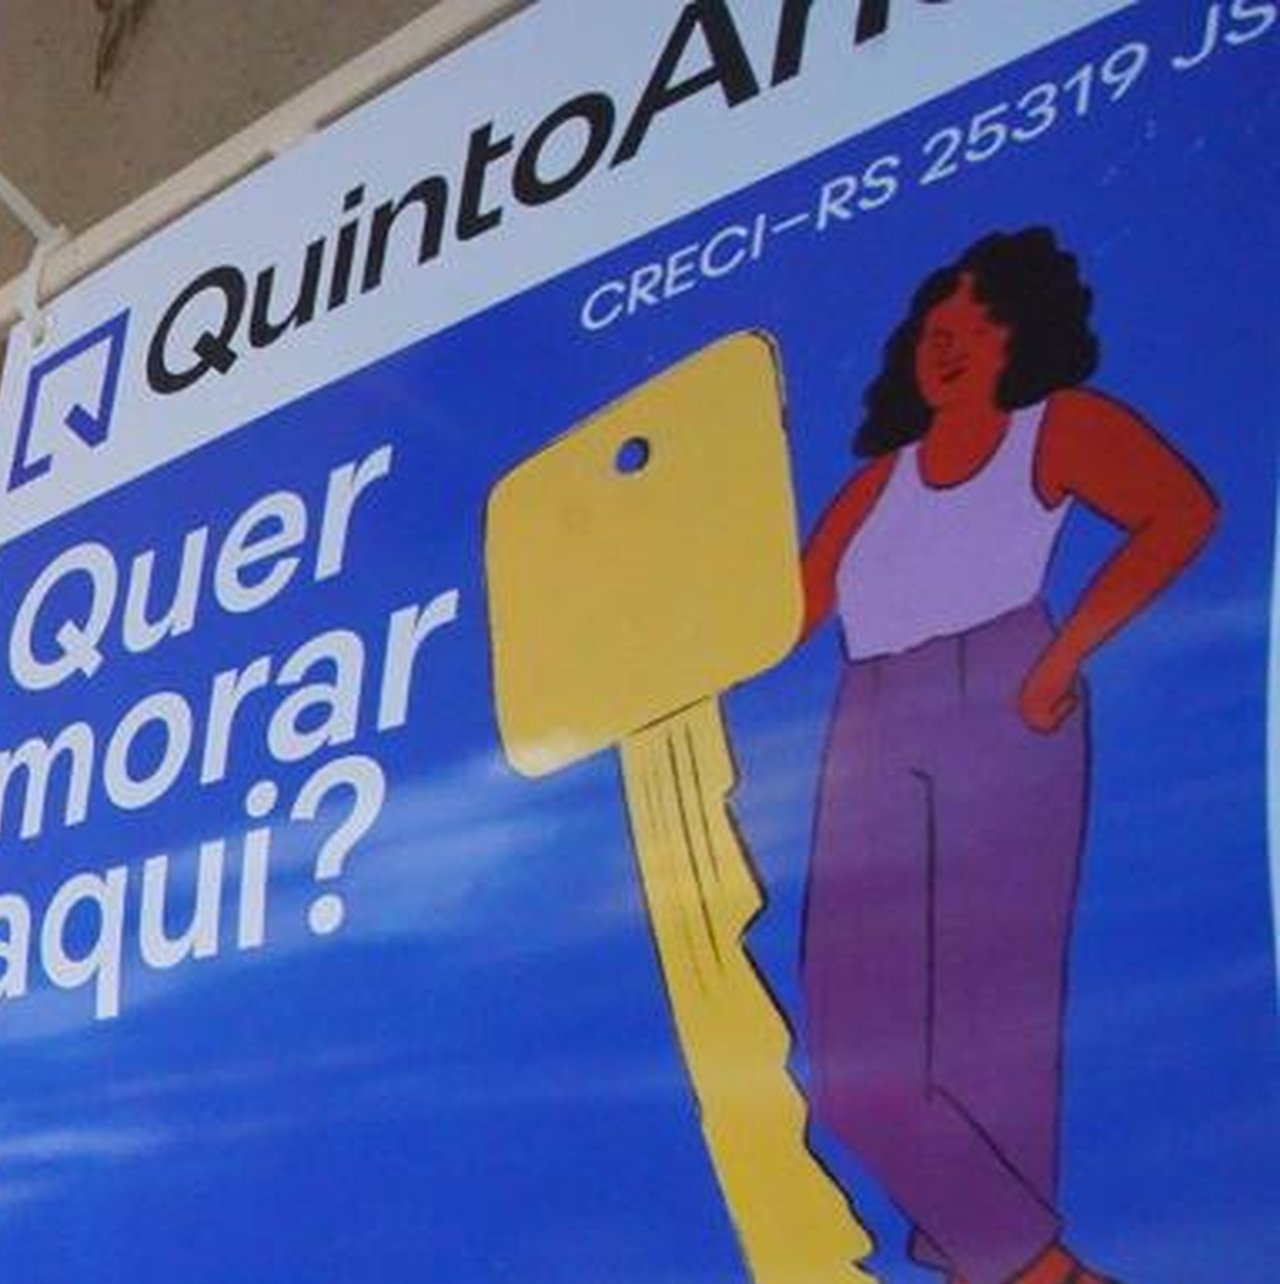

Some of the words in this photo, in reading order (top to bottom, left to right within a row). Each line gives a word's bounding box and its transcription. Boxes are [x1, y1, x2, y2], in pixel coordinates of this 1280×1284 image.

[143, 0, 955, 397] QuintoAn
[919, 41, 1149, 184] 25319
[8, 444, 393, 691] Quer
